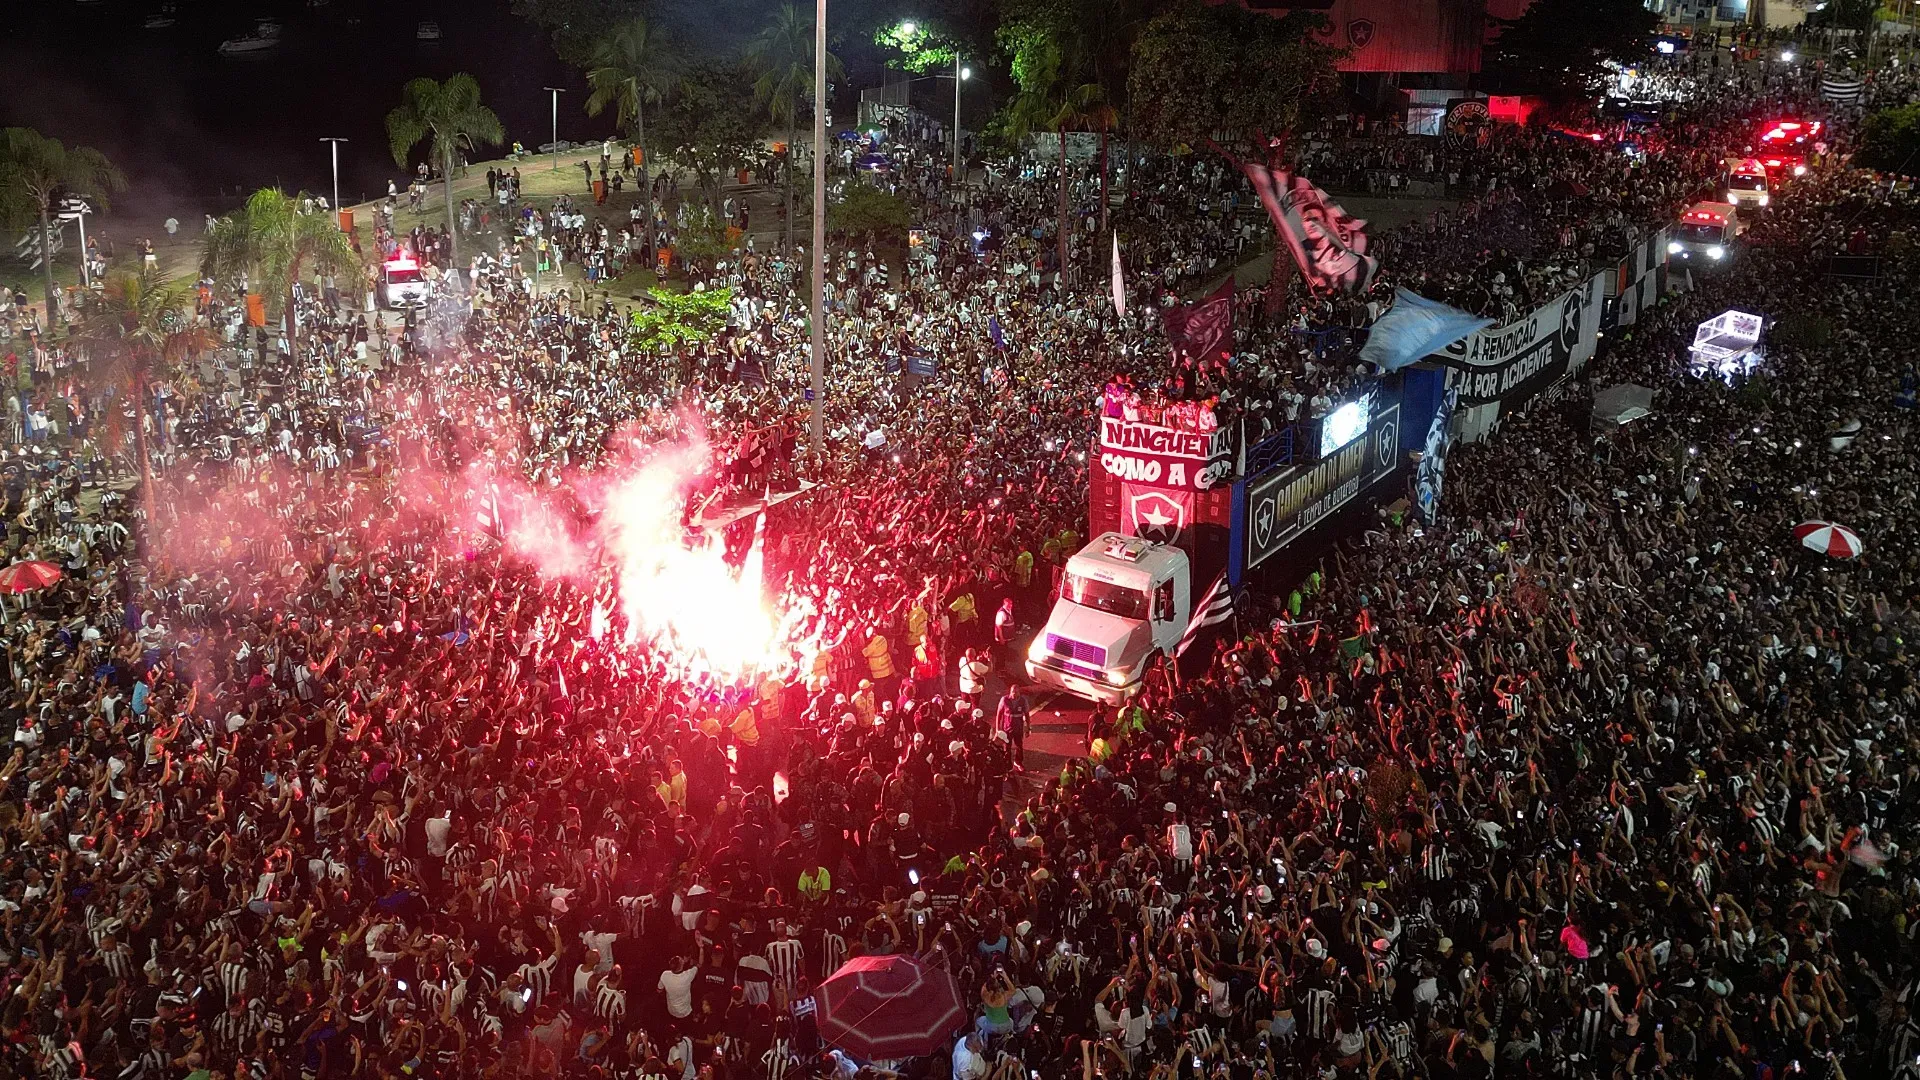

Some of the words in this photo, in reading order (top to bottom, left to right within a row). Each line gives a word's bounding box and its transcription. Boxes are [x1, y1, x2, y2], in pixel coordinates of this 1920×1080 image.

[1471, 335, 1481, 361] A
[1474, 372, 1498, 398] POR
[1500, 340, 1553, 393] ACIDENTE
[1101, 452, 1162, 482] COMO
[1167, 463, 1187, 486] A
[1303, 500, 1322, 525] TEMPO
[1324, 493, 1331, 512] DE
[1333, 475, 1359, 505] BOTAFOGO
